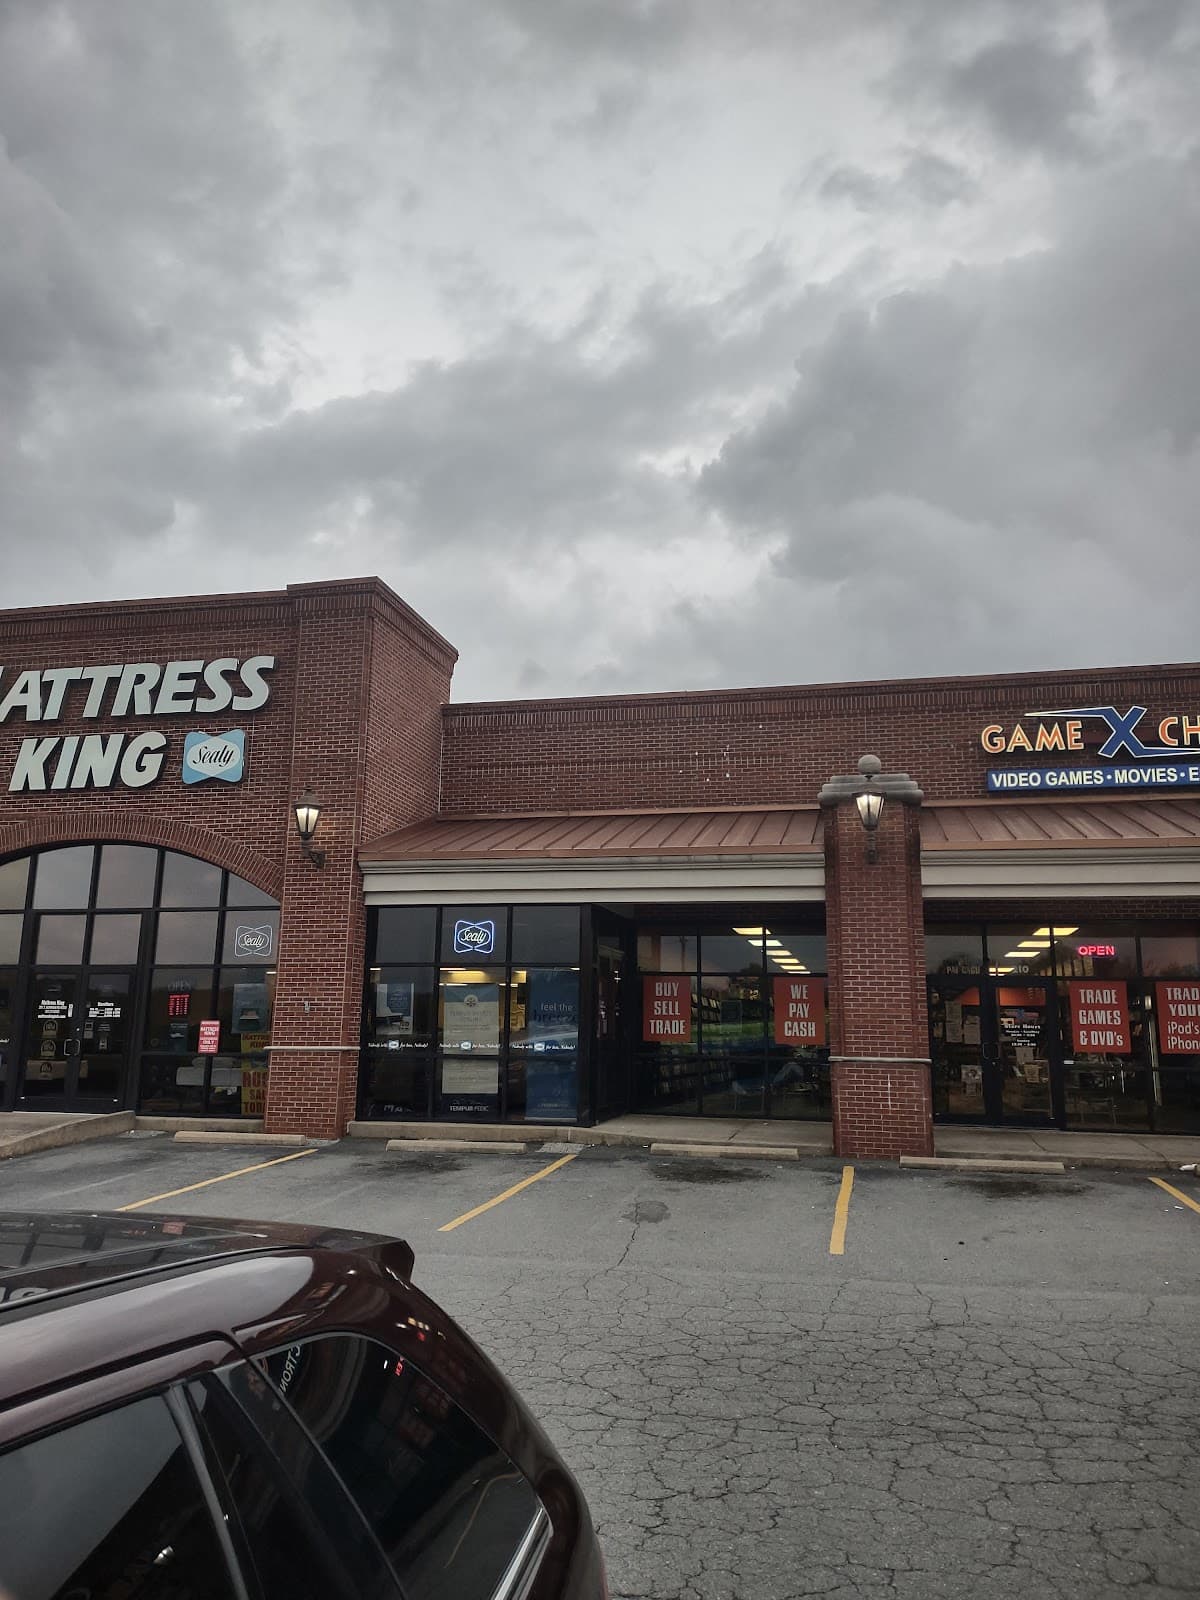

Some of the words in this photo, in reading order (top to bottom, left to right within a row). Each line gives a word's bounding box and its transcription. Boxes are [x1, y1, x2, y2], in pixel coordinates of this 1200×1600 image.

[0, 656, 275, 722] ATTRESS
[981, 720, 1085, 754] GAME
[8, 731, 167, 792] KING
[191, 745, 234, 768] Sealy
[992, 772, 1041, 788] VIDEO
[1045, 770, 1104, 786] GAMES
[1114, 767, 1178, 784] MOVIES
[241, 934, 265, 948] Sealy
[460, 929, 487, 944] Sealy
[1078, 945, 1115, 957] OPEN
[655, 982, 680, 997] BUY
[790, 984, 809, 1000] WE
[1079, 989, 1118, 1004] TRADE
[1166, 987, 1200, 1001] TRAD
[559, 1002, 573, 1012] the
[653, 1001, 681, 1016] SELL
[788, 1003, 810, 1018] PAY
[1078, 1010, 1122, 1025] GAMES
[649, 1020, 686, 1035] TRADE
[784, 1021, 816, 1037] CASH
[1167, 1021, 1200, 1035] iPod's
[1079, 1032, 1088, 1045] &
[1090, 1031, 1124, 1046] DVD's
[1167, 1036, 1200, 1050] iPhon
